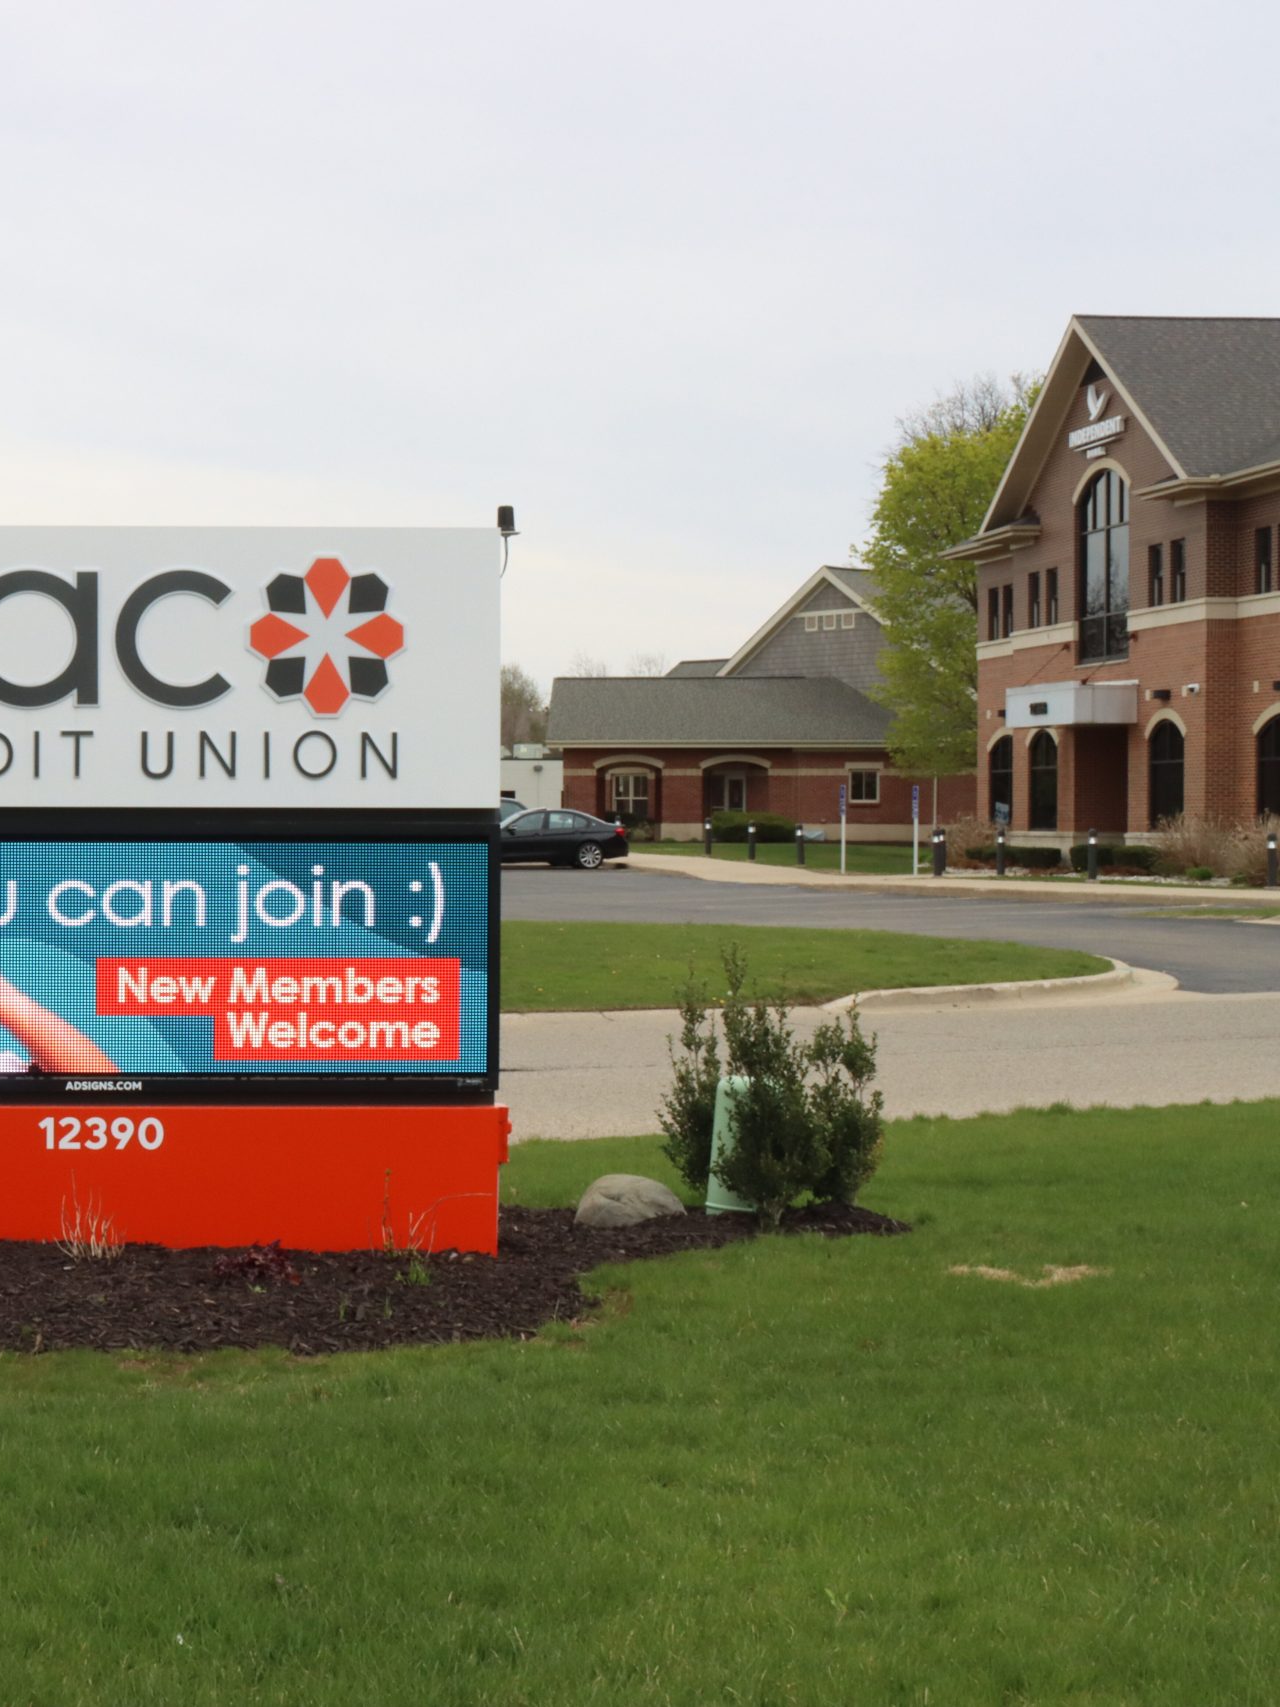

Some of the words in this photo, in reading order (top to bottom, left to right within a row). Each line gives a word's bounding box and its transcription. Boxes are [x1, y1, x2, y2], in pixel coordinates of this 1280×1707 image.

[140, 731, 399, 780] UNION
[47, 880, 206, 927] can
[230, 864, 376, 943] join
[116, 967, 216, 1003] New
[229, 966, 441, 1004] Members
[227, 1011, 441, 1049] Welcome
[65, 1081, 142, 1091] ADSIGNS.COM
[38, 1116, 164, 1150] 12390
